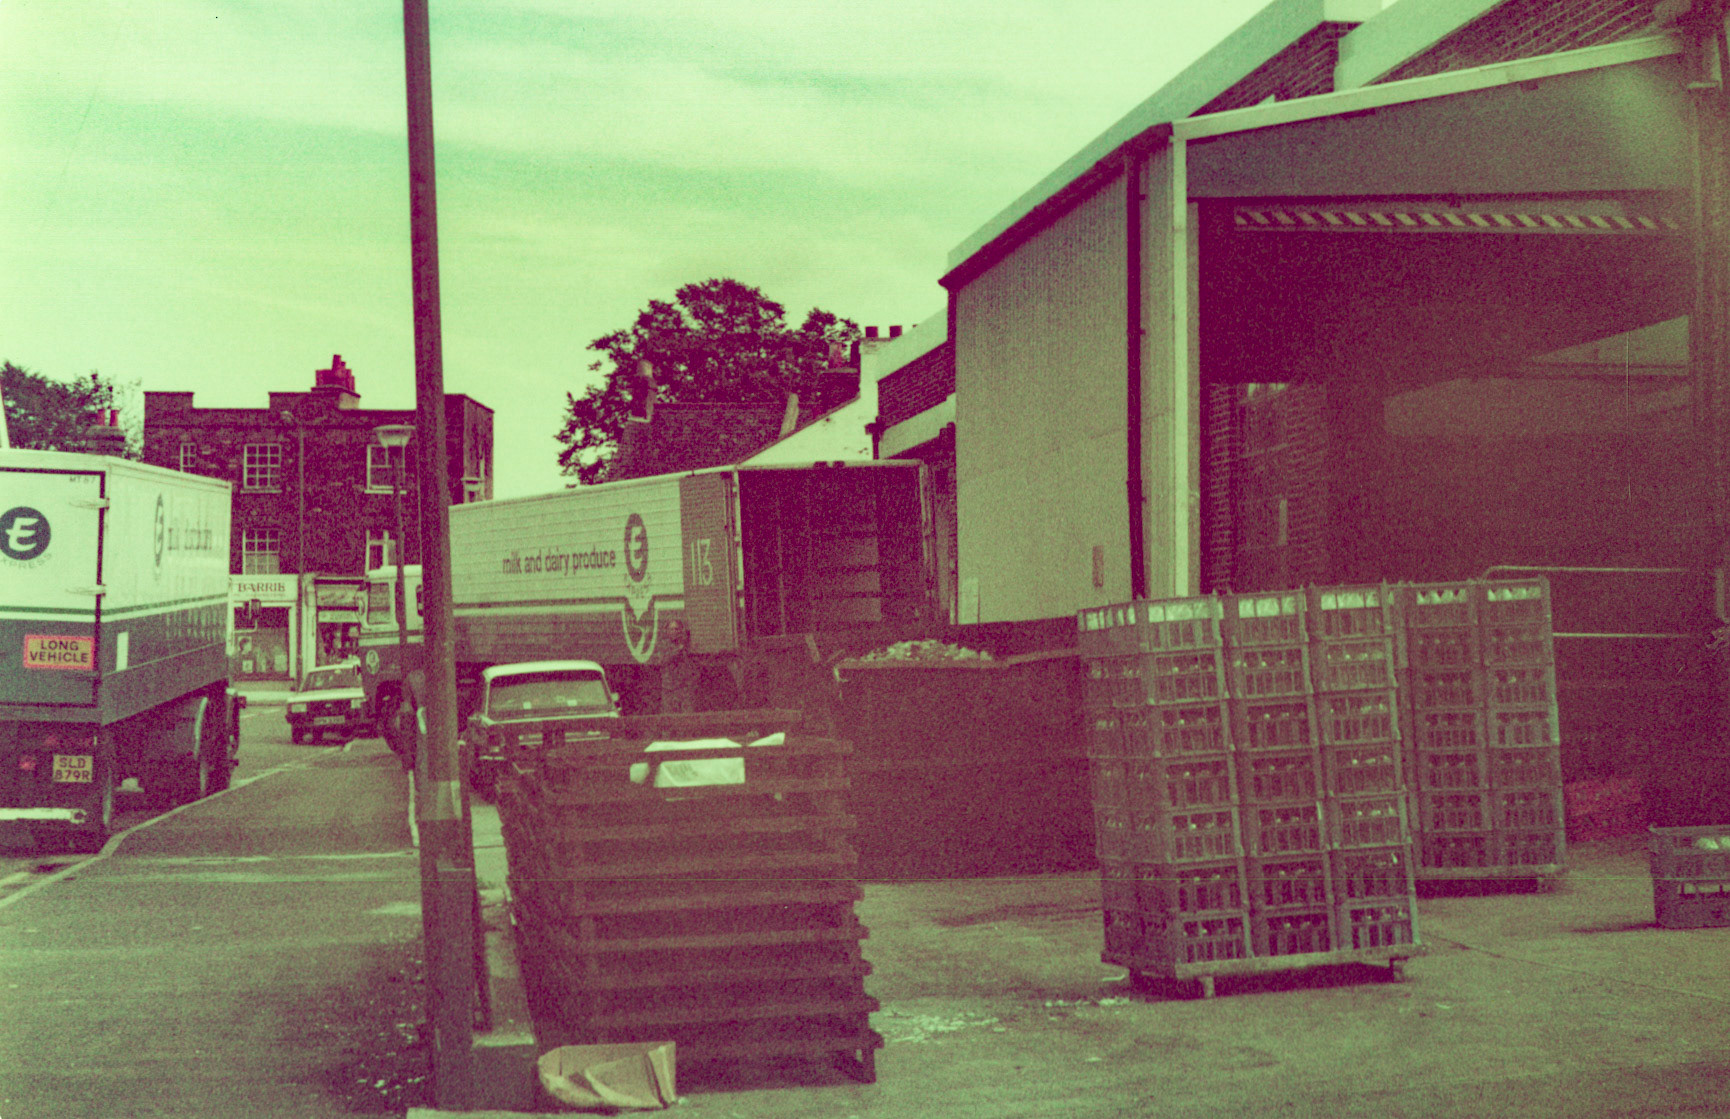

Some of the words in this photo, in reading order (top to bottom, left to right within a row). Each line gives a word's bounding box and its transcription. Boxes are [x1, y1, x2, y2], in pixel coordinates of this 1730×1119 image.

[502, 550, 522, 574] milk
[524, 548, 542, 574] and
[545, 546, 570, 576] dairy
[571, 543, 616, 576] produce
[40, 640, 79, 651] LONG
[30, 651, 89, 663] VEHICLE
[59, 757, 86, 769] SLD
[55, 769, 90, 781] 879R
